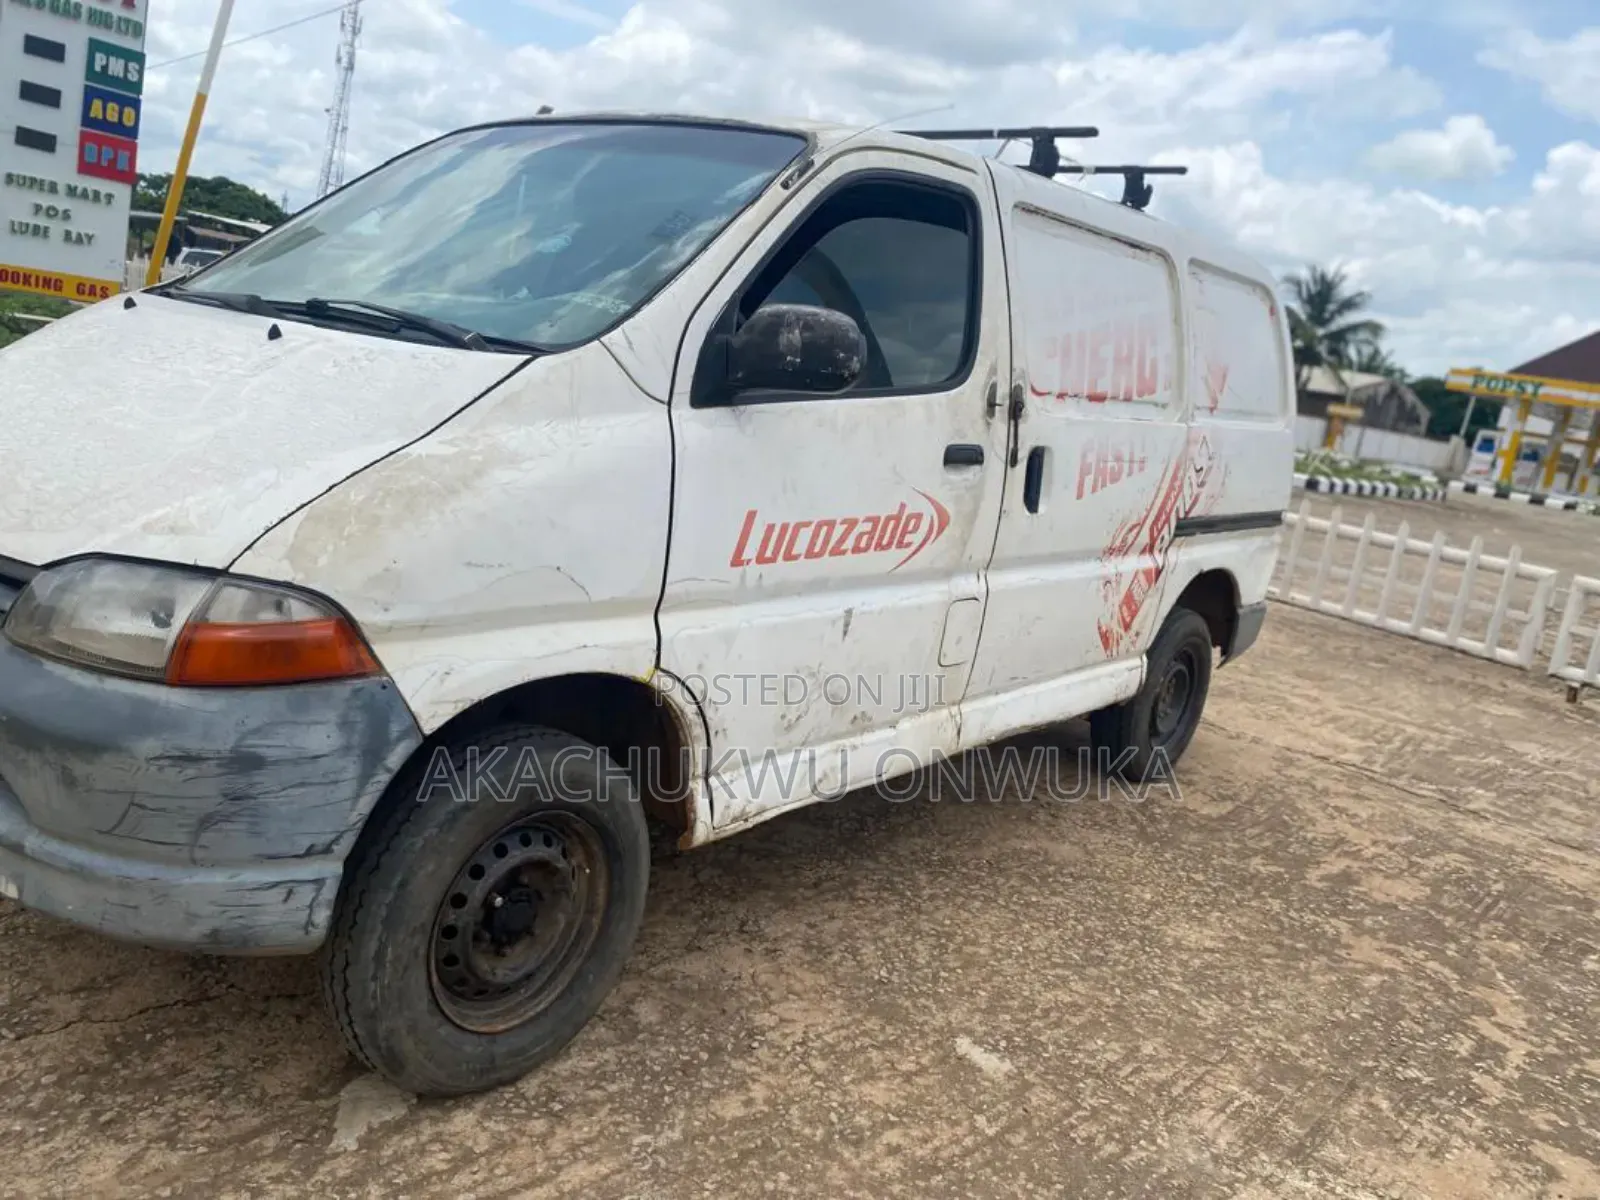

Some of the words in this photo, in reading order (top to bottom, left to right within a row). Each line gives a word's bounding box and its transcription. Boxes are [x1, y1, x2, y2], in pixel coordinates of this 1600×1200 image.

[48, 0, 82, 20] GAS
[115, 15, 143, 39] LTD
[94, 52, 140, 82] PMS
[89, 98, 136, 127] AGO
[5, 171, 59, 195] SUPER
[64, 183, 115, 206] MART
[33, 202, 72, 221] POS
[10, 219, 51, 240] LUBE
[63, 229, 95, 246] BAY
[76, 282, 110, 299] GAS
[1470, 374, 1543, 398] POPSY
[730, 502, 923, 567] Lucozade
